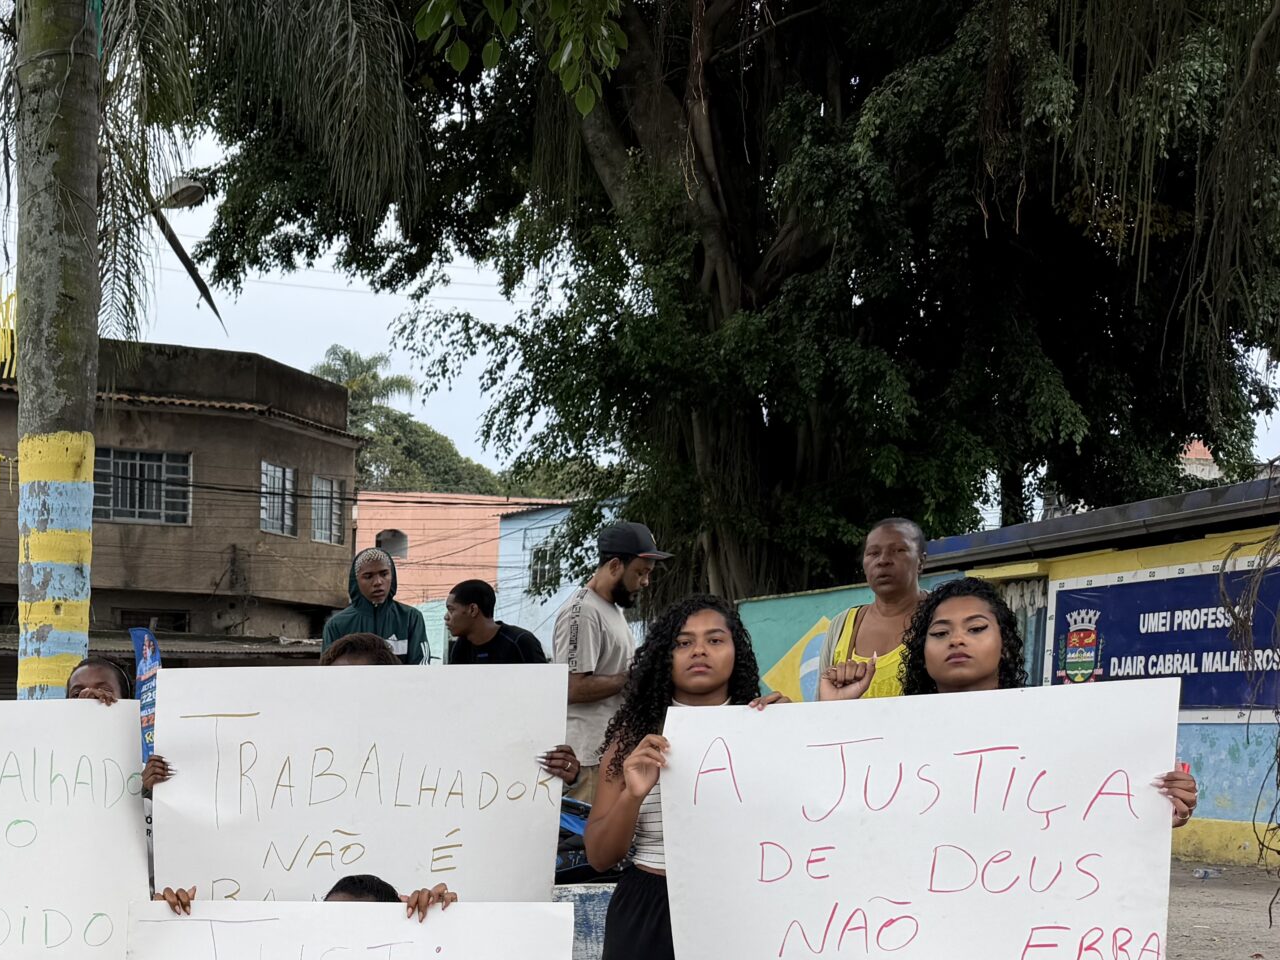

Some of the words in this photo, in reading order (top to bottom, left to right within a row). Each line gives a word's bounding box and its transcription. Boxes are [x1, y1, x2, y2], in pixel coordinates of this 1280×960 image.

[1139, 611, 1171, 634] UMEI
[1109, 656, 1145, 677] DJAIR
[1148, 652, 1198, 675] CABRAL
[180, 712, 556, 829] TRABALHADOR
[693, 736, 743, 806] A
[262, 829, 366, 871] NÃO
[431, 827, 462, 872] É
[758, 841, 836, 883] DE
[778, 896, 919, 959] NÃO
